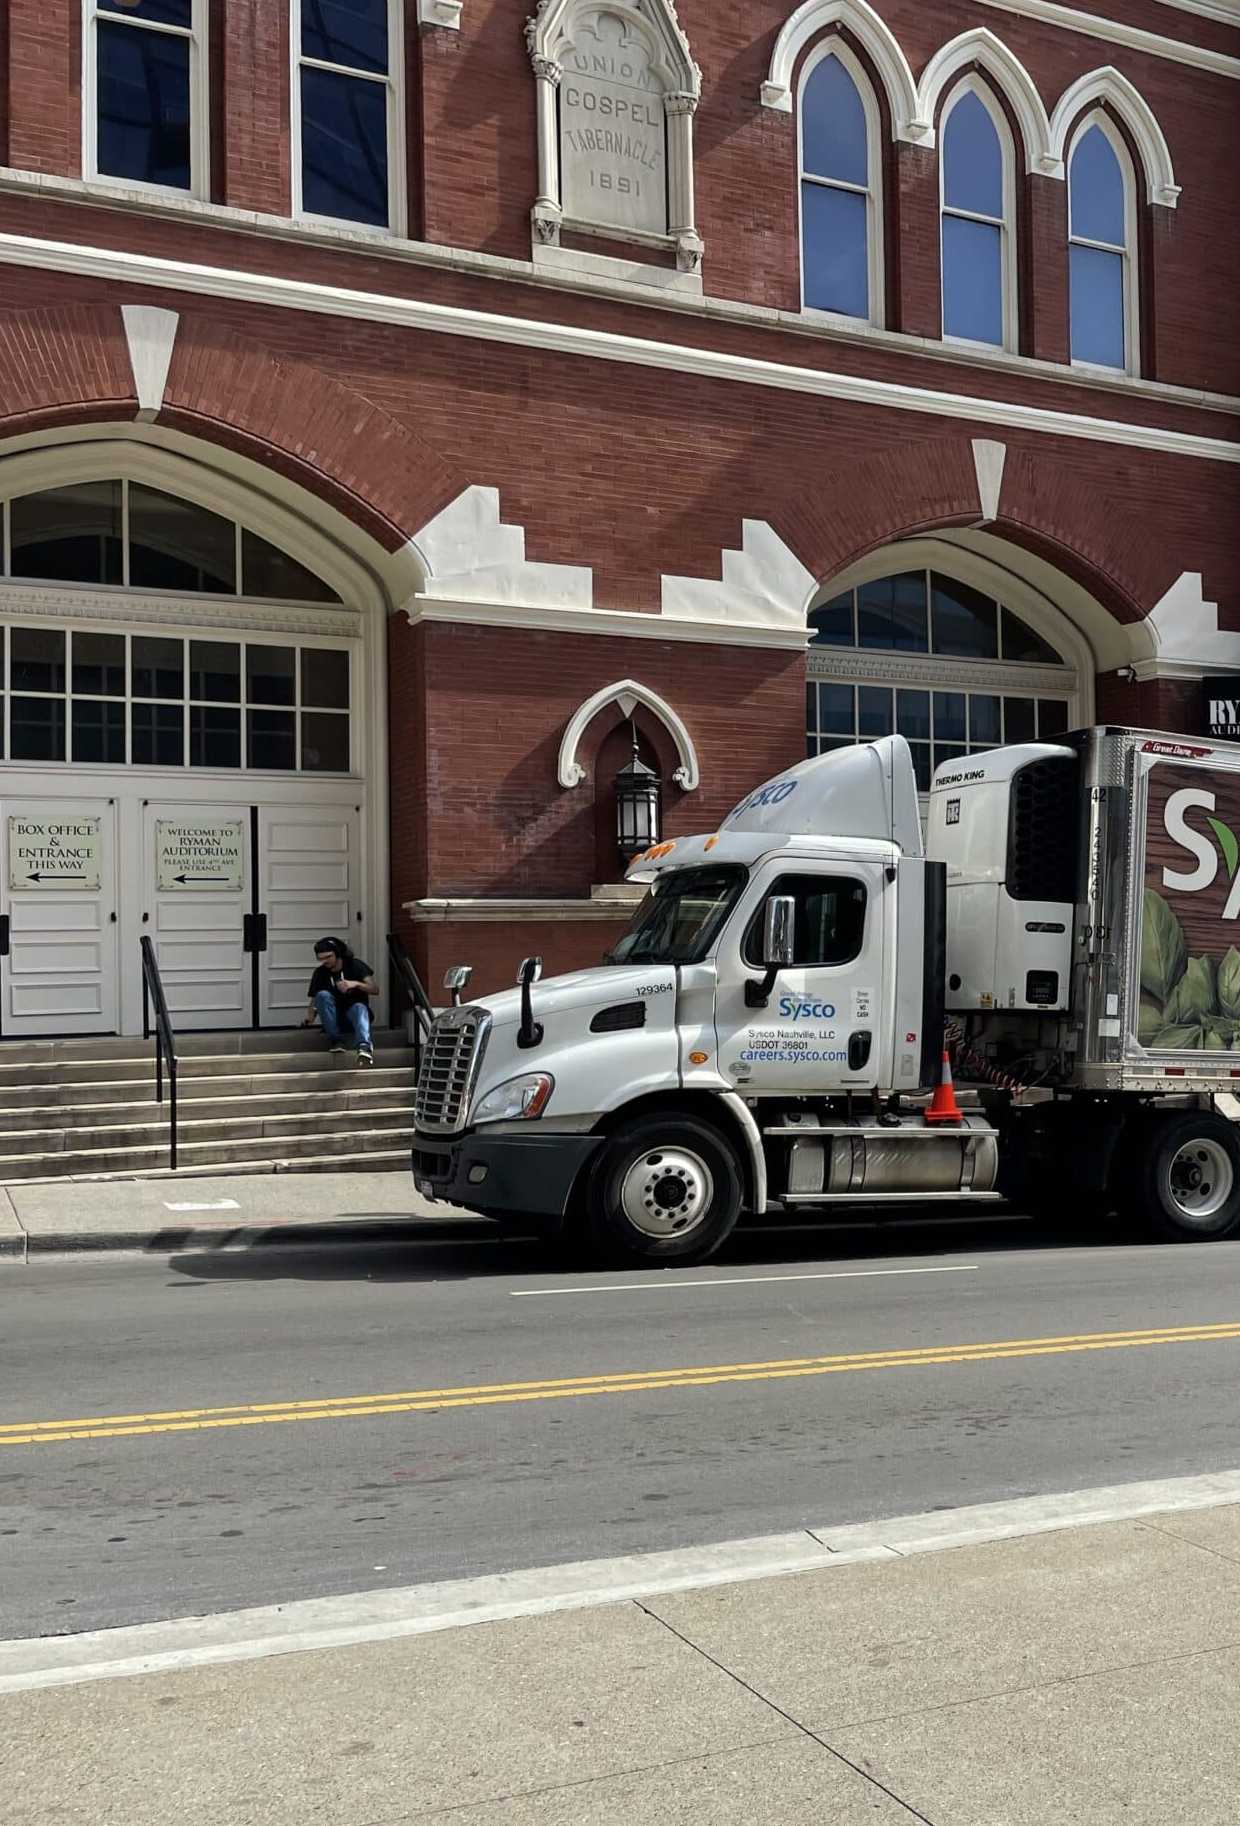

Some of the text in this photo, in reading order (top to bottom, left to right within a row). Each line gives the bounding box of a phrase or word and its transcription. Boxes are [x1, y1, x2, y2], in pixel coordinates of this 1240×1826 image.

[575, 55, 651, 87] UNION
[566, 88, 659, 127] GOSPEL
[566, 128, 662, 170] TABERNACLE
[590, 170, 640, 197] 1891
[935, 769, 985, 787] THERMO KING
[17, 824, 94, 836] BOX OFFICE
[168, 828, 233, 837] WELCOME TO
[49, 836, 60, 847] &
[179, 837, 221, 846] RYMAN
[18, 848, 93, 858] ENTRANCE
[162, 847, 238, 857] AUDITORIUM
[26, 860, 84, 870] THIS WAY
[636, 982, 673, 997] 129364
[779, 998, 836, 1021] Sysco
[748, 1029, 775, 1040] Sysco
[819, 1031, 836, 1040] LLC
[748, 1041, 808, 1050] USDOT 36801
[740, 1050, 847, 1064] careers.sysco.com
